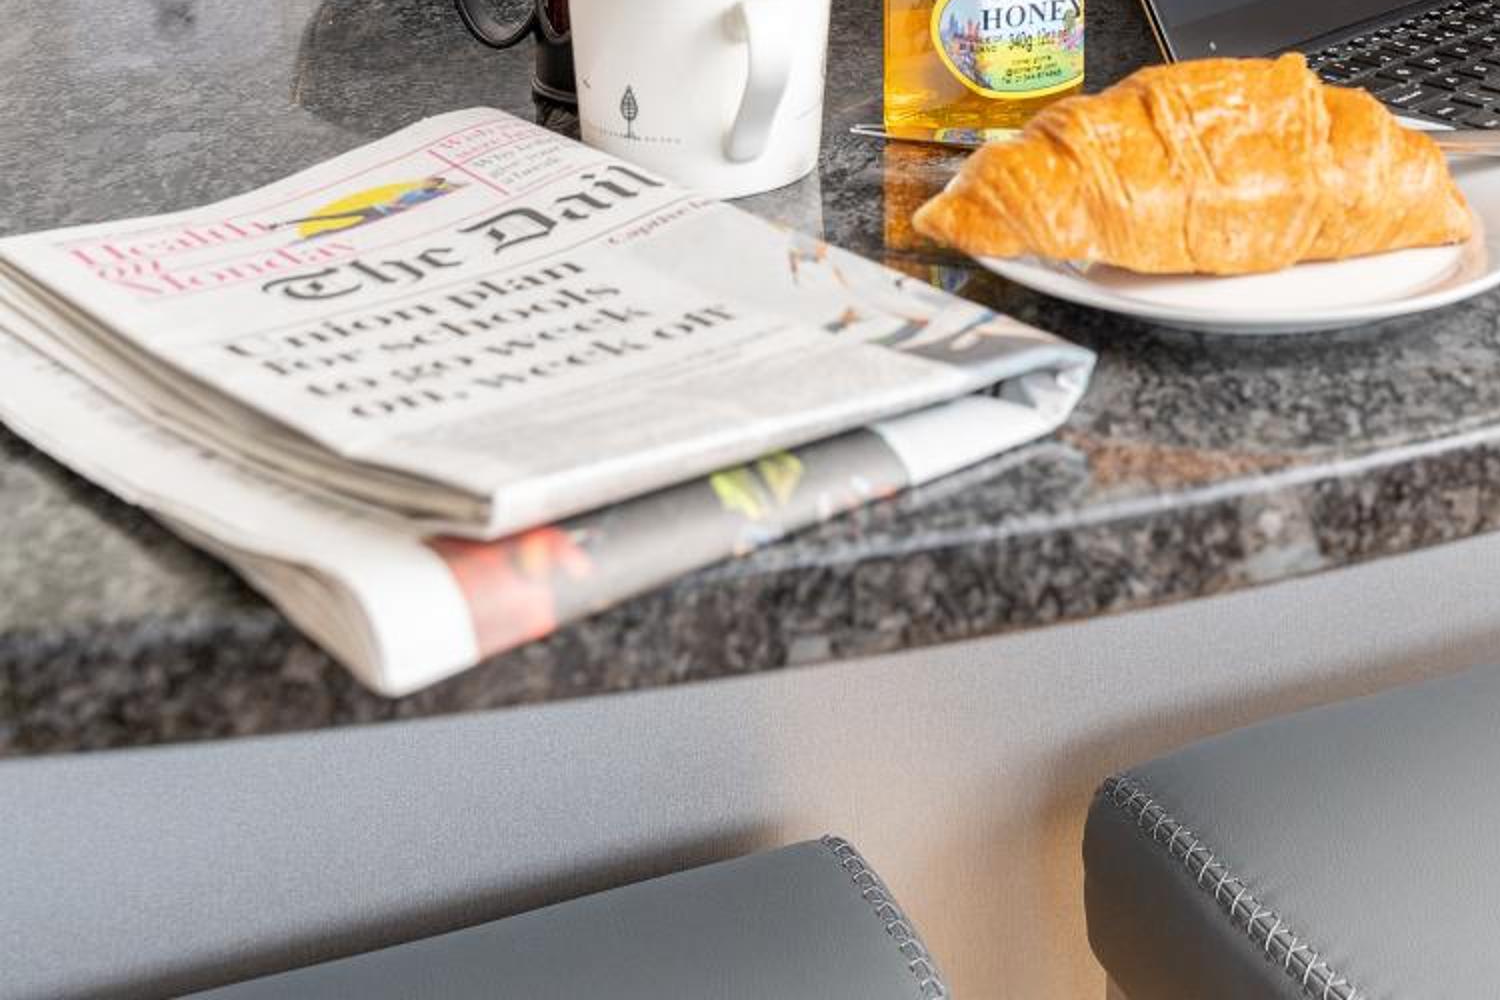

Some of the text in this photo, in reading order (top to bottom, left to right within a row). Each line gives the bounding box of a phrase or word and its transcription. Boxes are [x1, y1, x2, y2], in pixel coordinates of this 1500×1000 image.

[224, 262, 585, 358] Union plan
[262, 247, 462, 301] The
[260, 287, 621, 377] for schools
[305, 307, 652, 397] to go week
[473, 338, 650, 390] week
